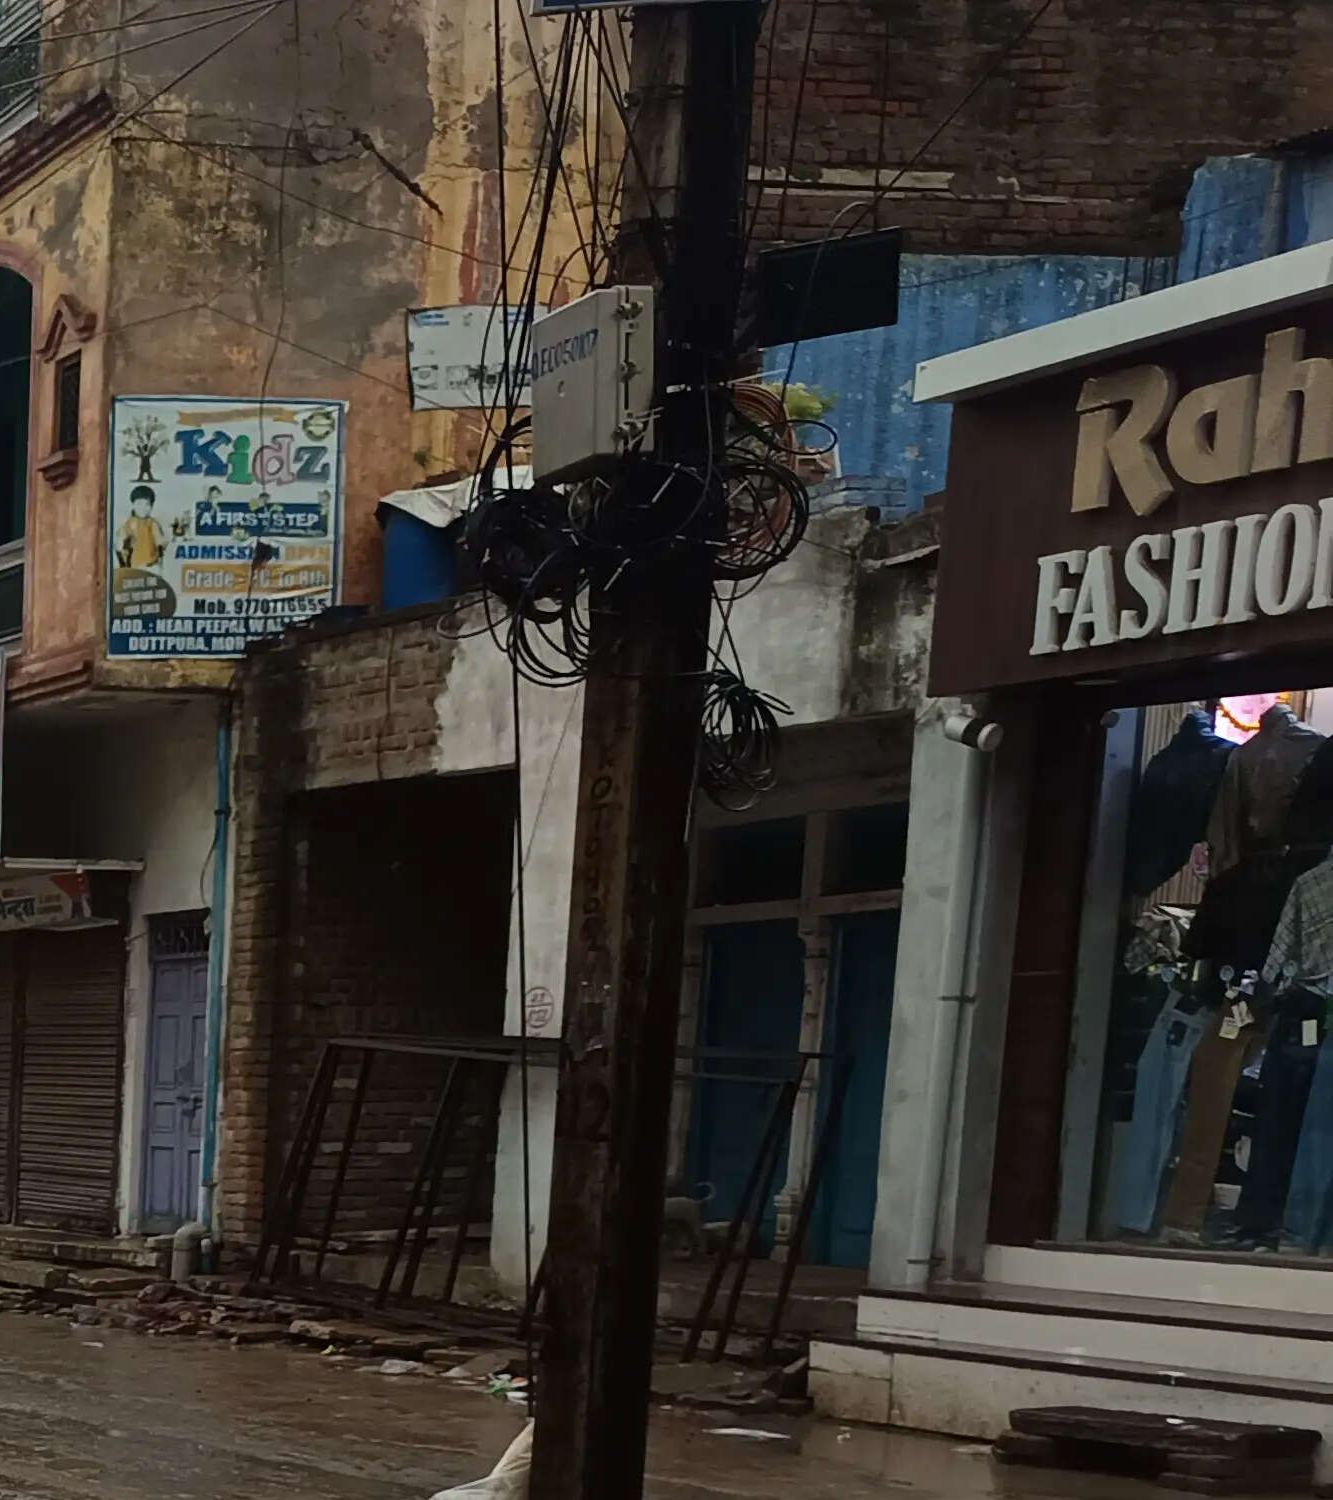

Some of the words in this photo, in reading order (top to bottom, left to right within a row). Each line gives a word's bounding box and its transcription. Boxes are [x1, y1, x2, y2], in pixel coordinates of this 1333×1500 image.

[174, 428, 331, 487] Kidz
[199, 511, 213, 527] A
[271, 513, 320, 528] STEP
[185, 569, 233, 589] Grade
[193, 598, 231, 615] Mob.
[156, 618, 193, 634] NEAR
